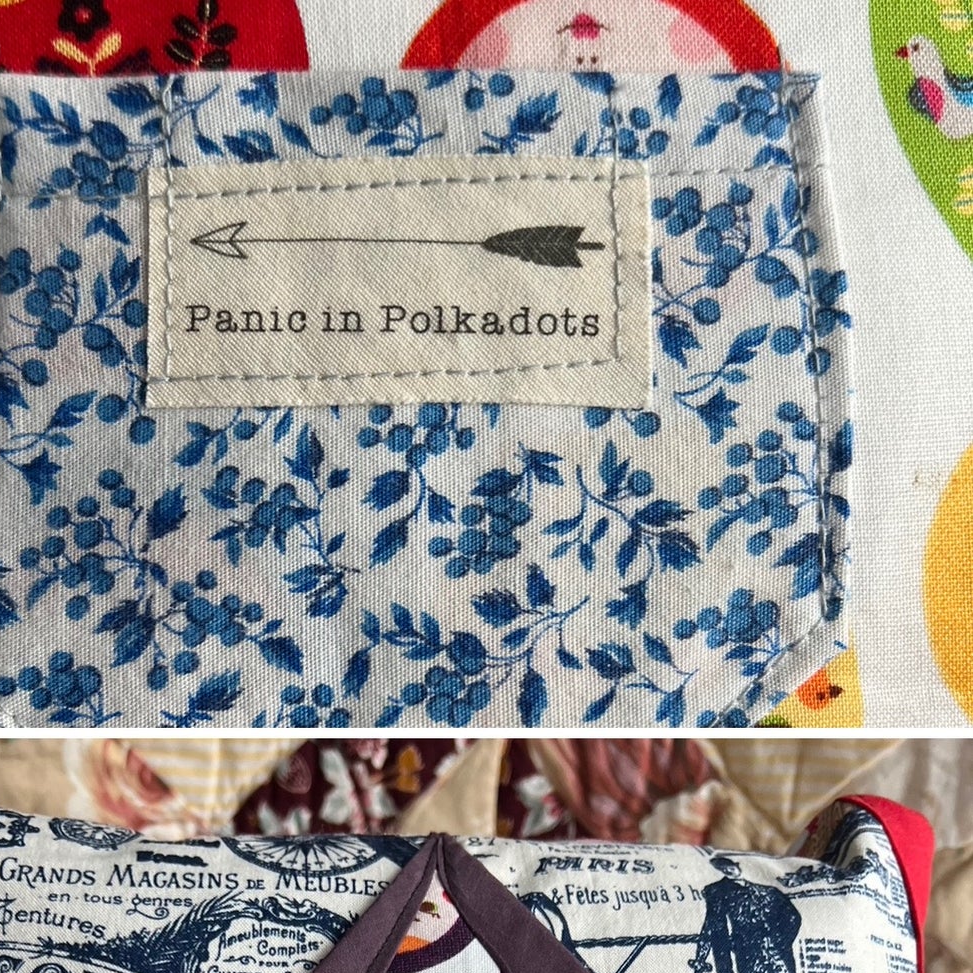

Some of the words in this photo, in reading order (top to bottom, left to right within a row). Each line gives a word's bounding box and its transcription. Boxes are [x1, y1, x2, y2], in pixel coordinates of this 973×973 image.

[185, 304, 308, 333] Panic
[321, 305, 365, 333] in
[380, 304, 601, 337] Polkadots
[0, 857, 96, 890] GRANDS
[106, 864, 239, 890] MAGASINS
[246, 879, 265, 890] DE
[277, 871, 390, 897] MEUBLES
[47, 893, 71, 902] en
[83, 891, 123, 905] tous
[125, 893, 194, 920] genres
[552, 887, 564, 905] &
[565, 884, 609, 905] Fêtes
[673, 885, 685, 902] 3
[214, 922, 307, 962] Ameublements
[257, 939, 320, 959] Complets
